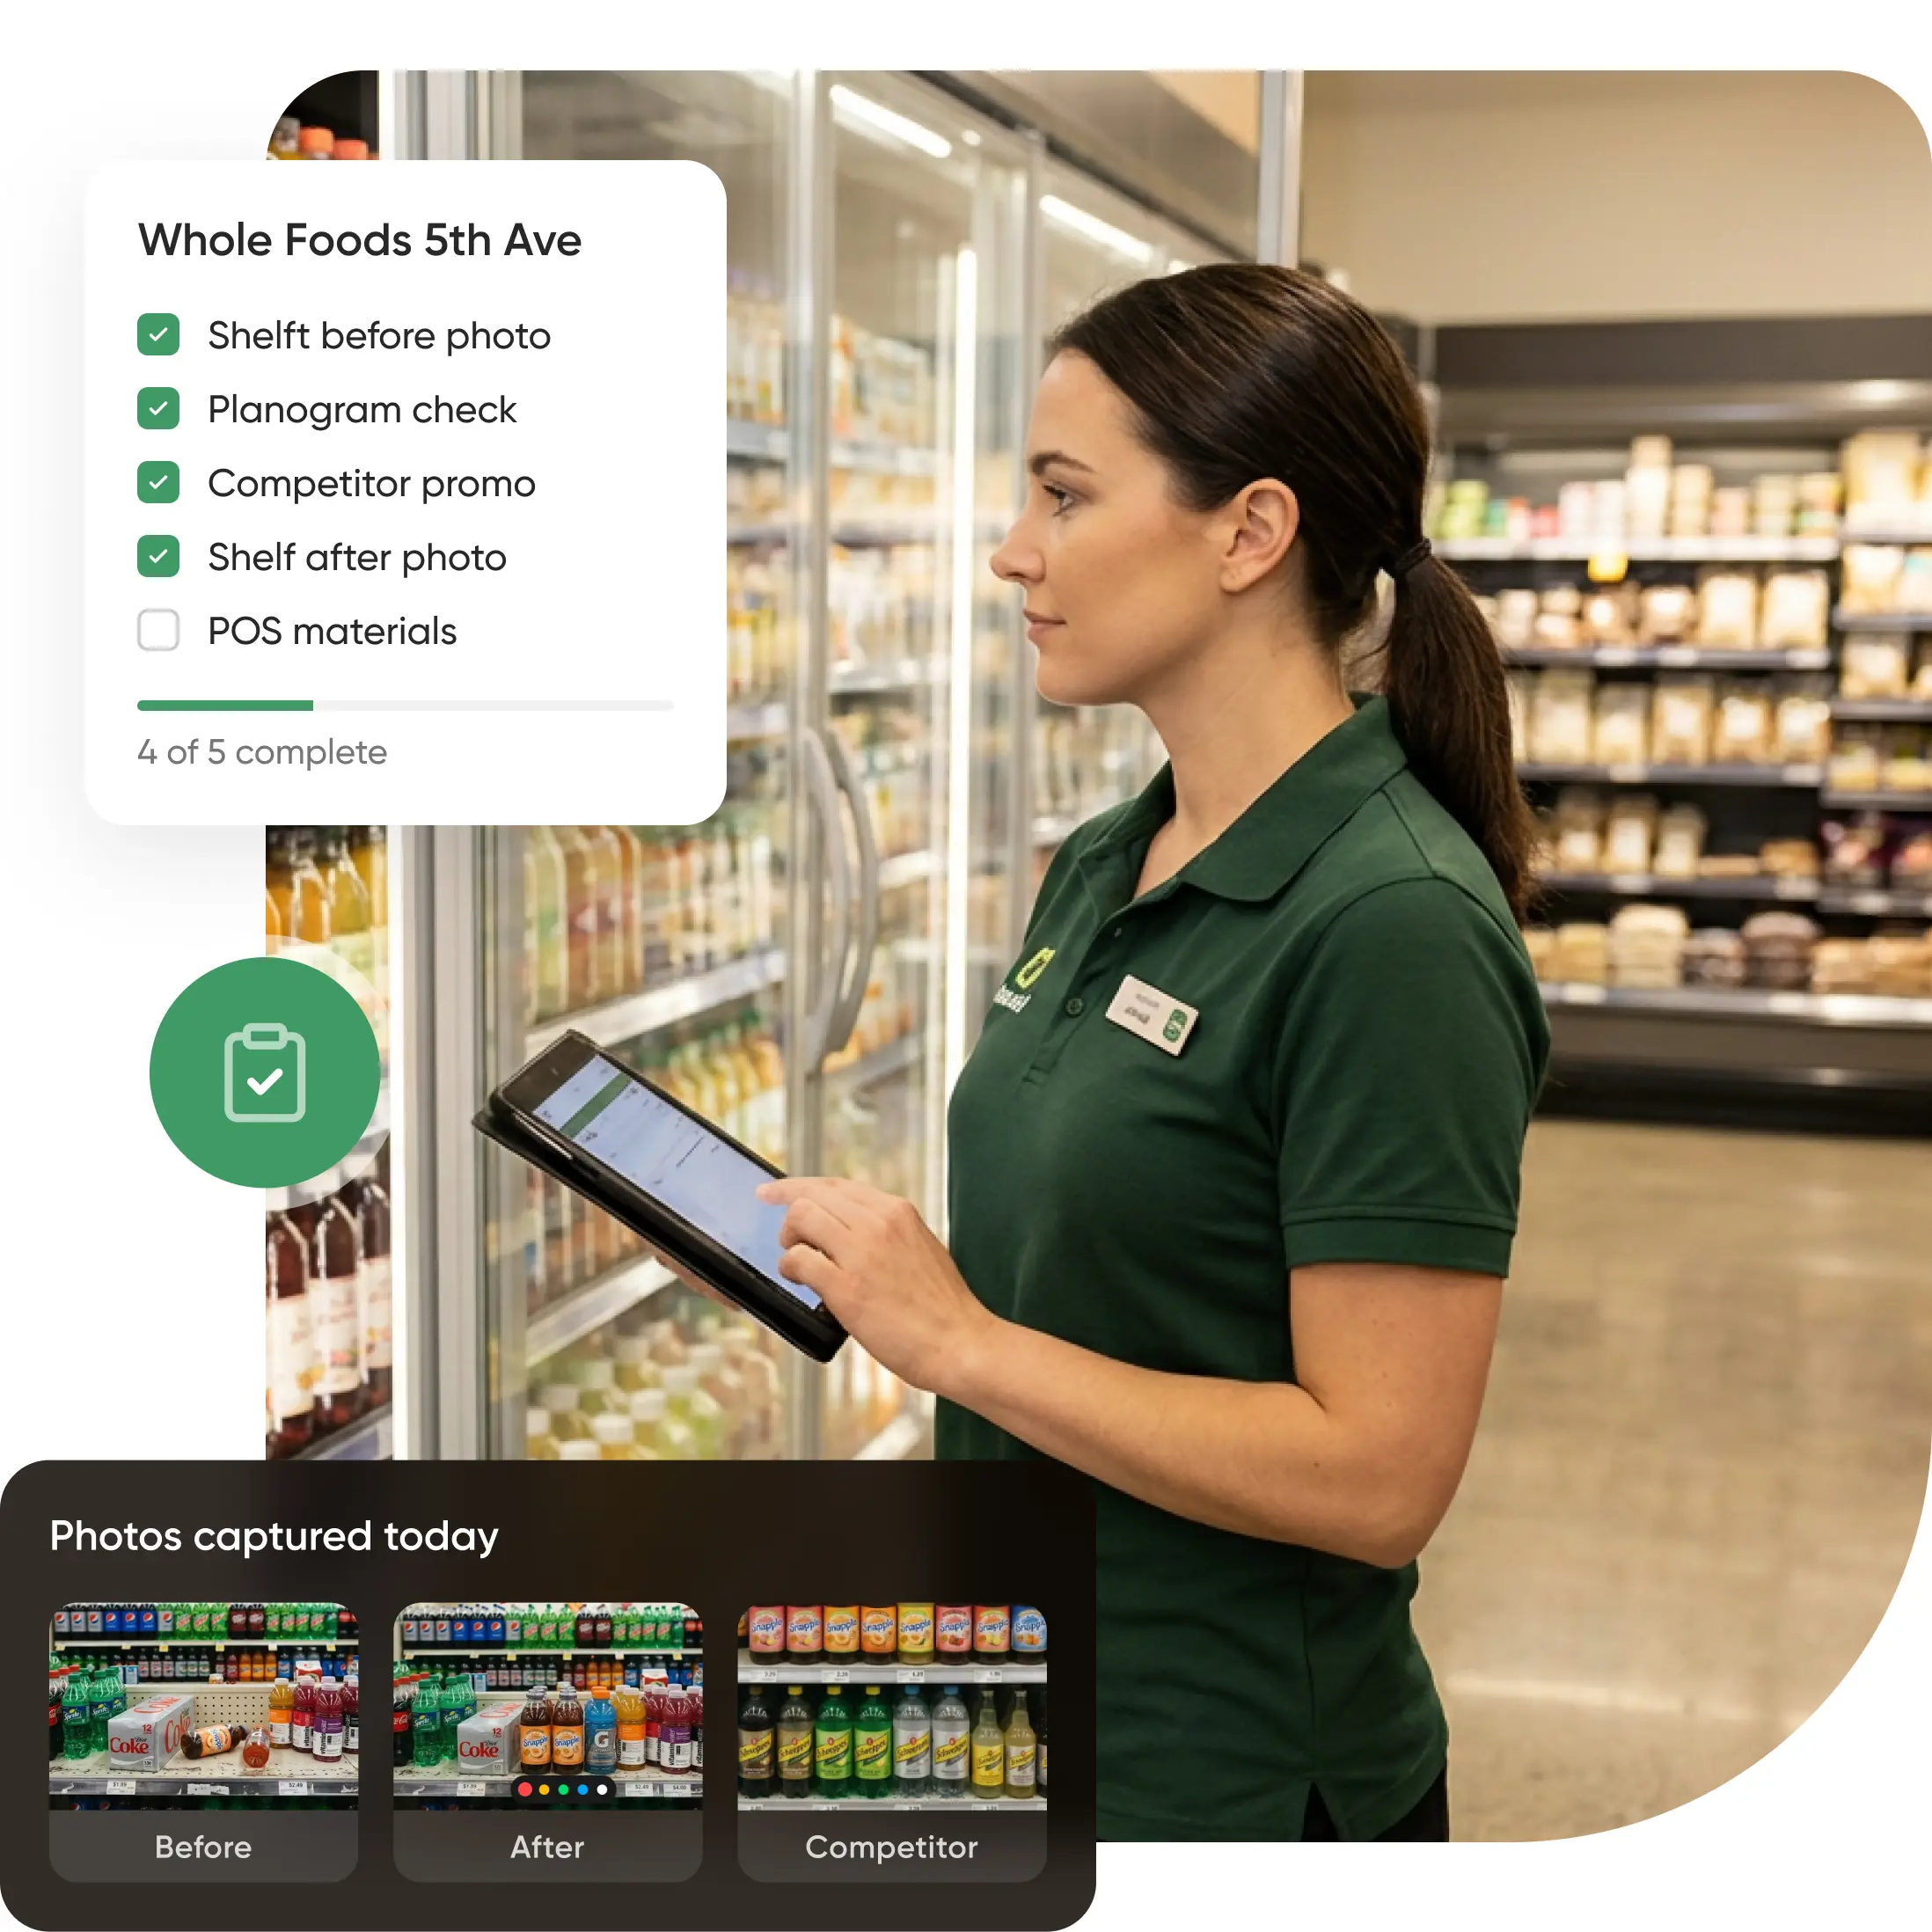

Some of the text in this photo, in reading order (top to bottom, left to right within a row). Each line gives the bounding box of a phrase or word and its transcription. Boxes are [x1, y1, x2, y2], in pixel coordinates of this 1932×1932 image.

[751, 1619, 782, 1632] Snapple
[789, 1619, 820, 1632] Snapple
[826, 1619, 857, 1633] Snapple
[862, 1619, 893, 1633] Snapple
[900, 1619, 932, 1632] Snapple
[939, 1619, 970, 1632] Snapple
[977, 1619, 1009, 1632] Snapple
[109, 1737, 150, 1754] Coke
[523, 1735, 549, 1748] Snapple
[554, 1735, 580, 1747] Snapple
[594, 1731, 609, 1748] G
[459, 1741, 499, 1758] Coke
